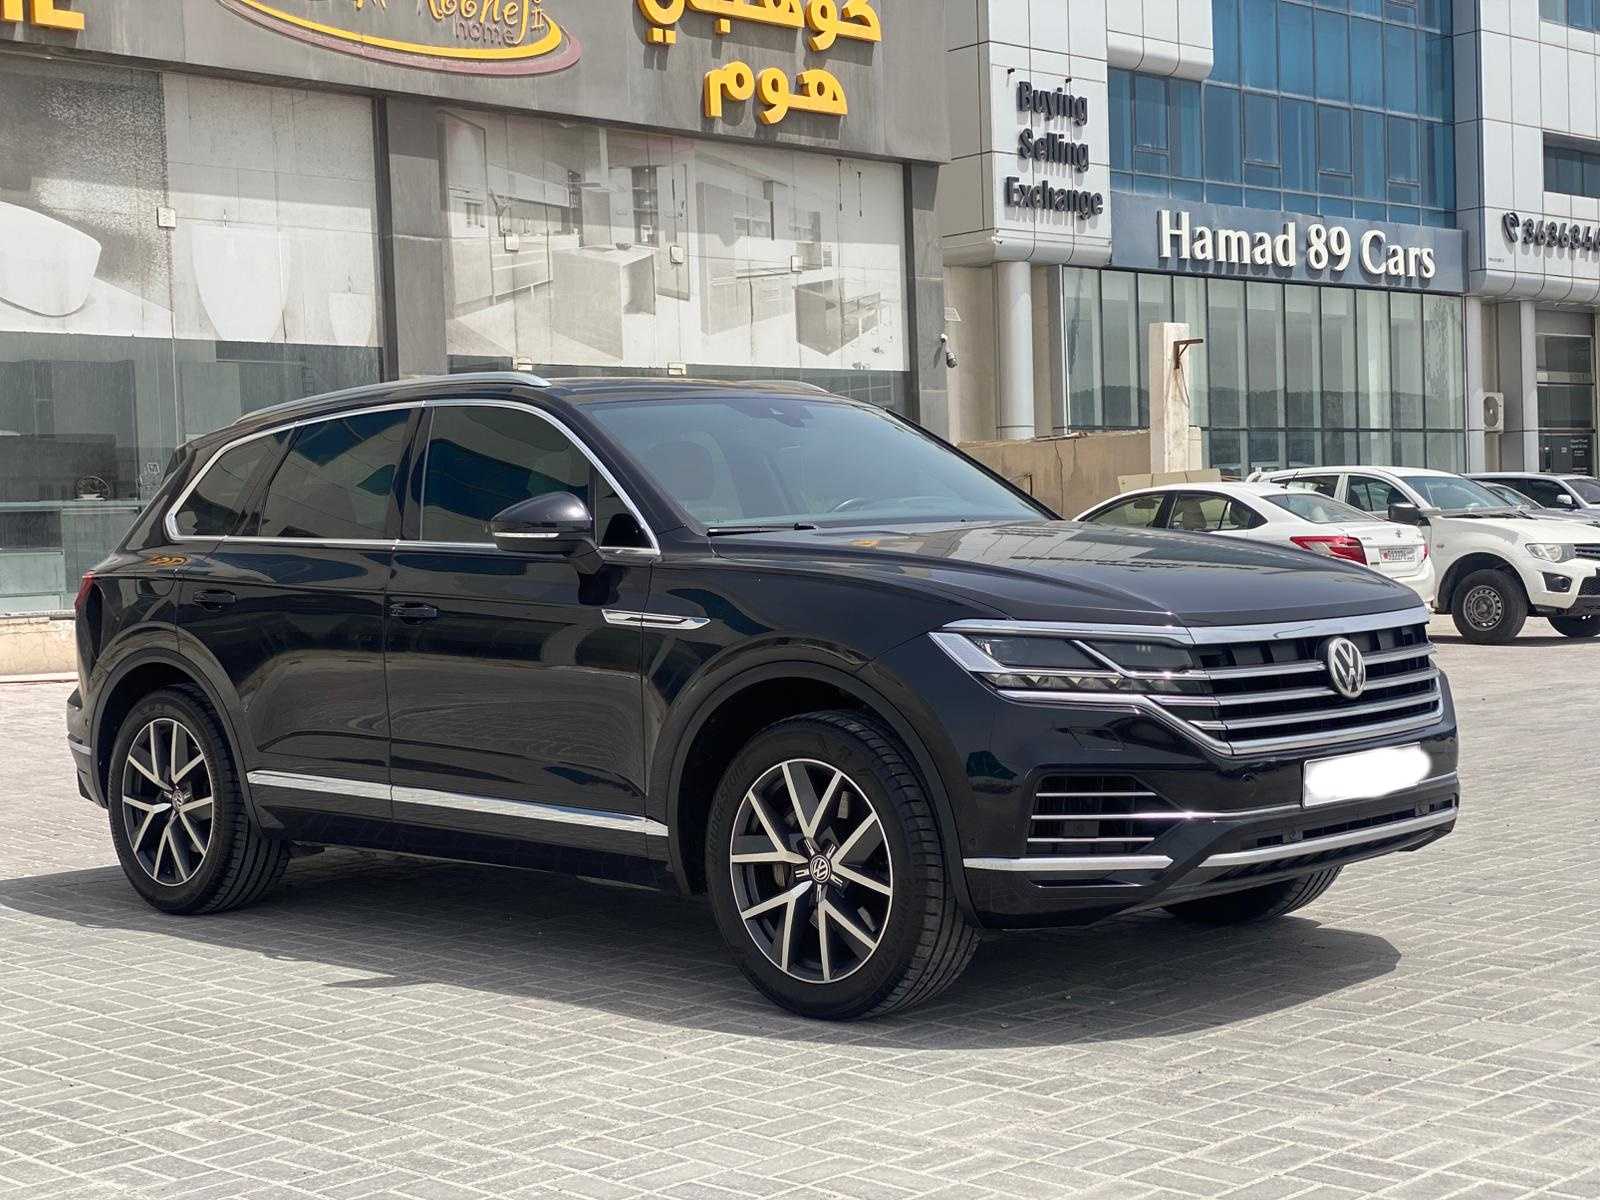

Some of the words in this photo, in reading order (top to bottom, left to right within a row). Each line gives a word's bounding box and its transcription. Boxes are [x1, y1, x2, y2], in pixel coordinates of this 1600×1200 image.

[704, 60, 848, 125] هوم
[1017, 81, 1088, 127] Buying
[1018, 128, 1090, 173] Selling
[1004, 176, 1104, 220] Exchange
[1157, 209, 1297, 268] Hamad
[1305, 223, 1352, 272] 89
[1360, 229, 1436, 279] Cars
